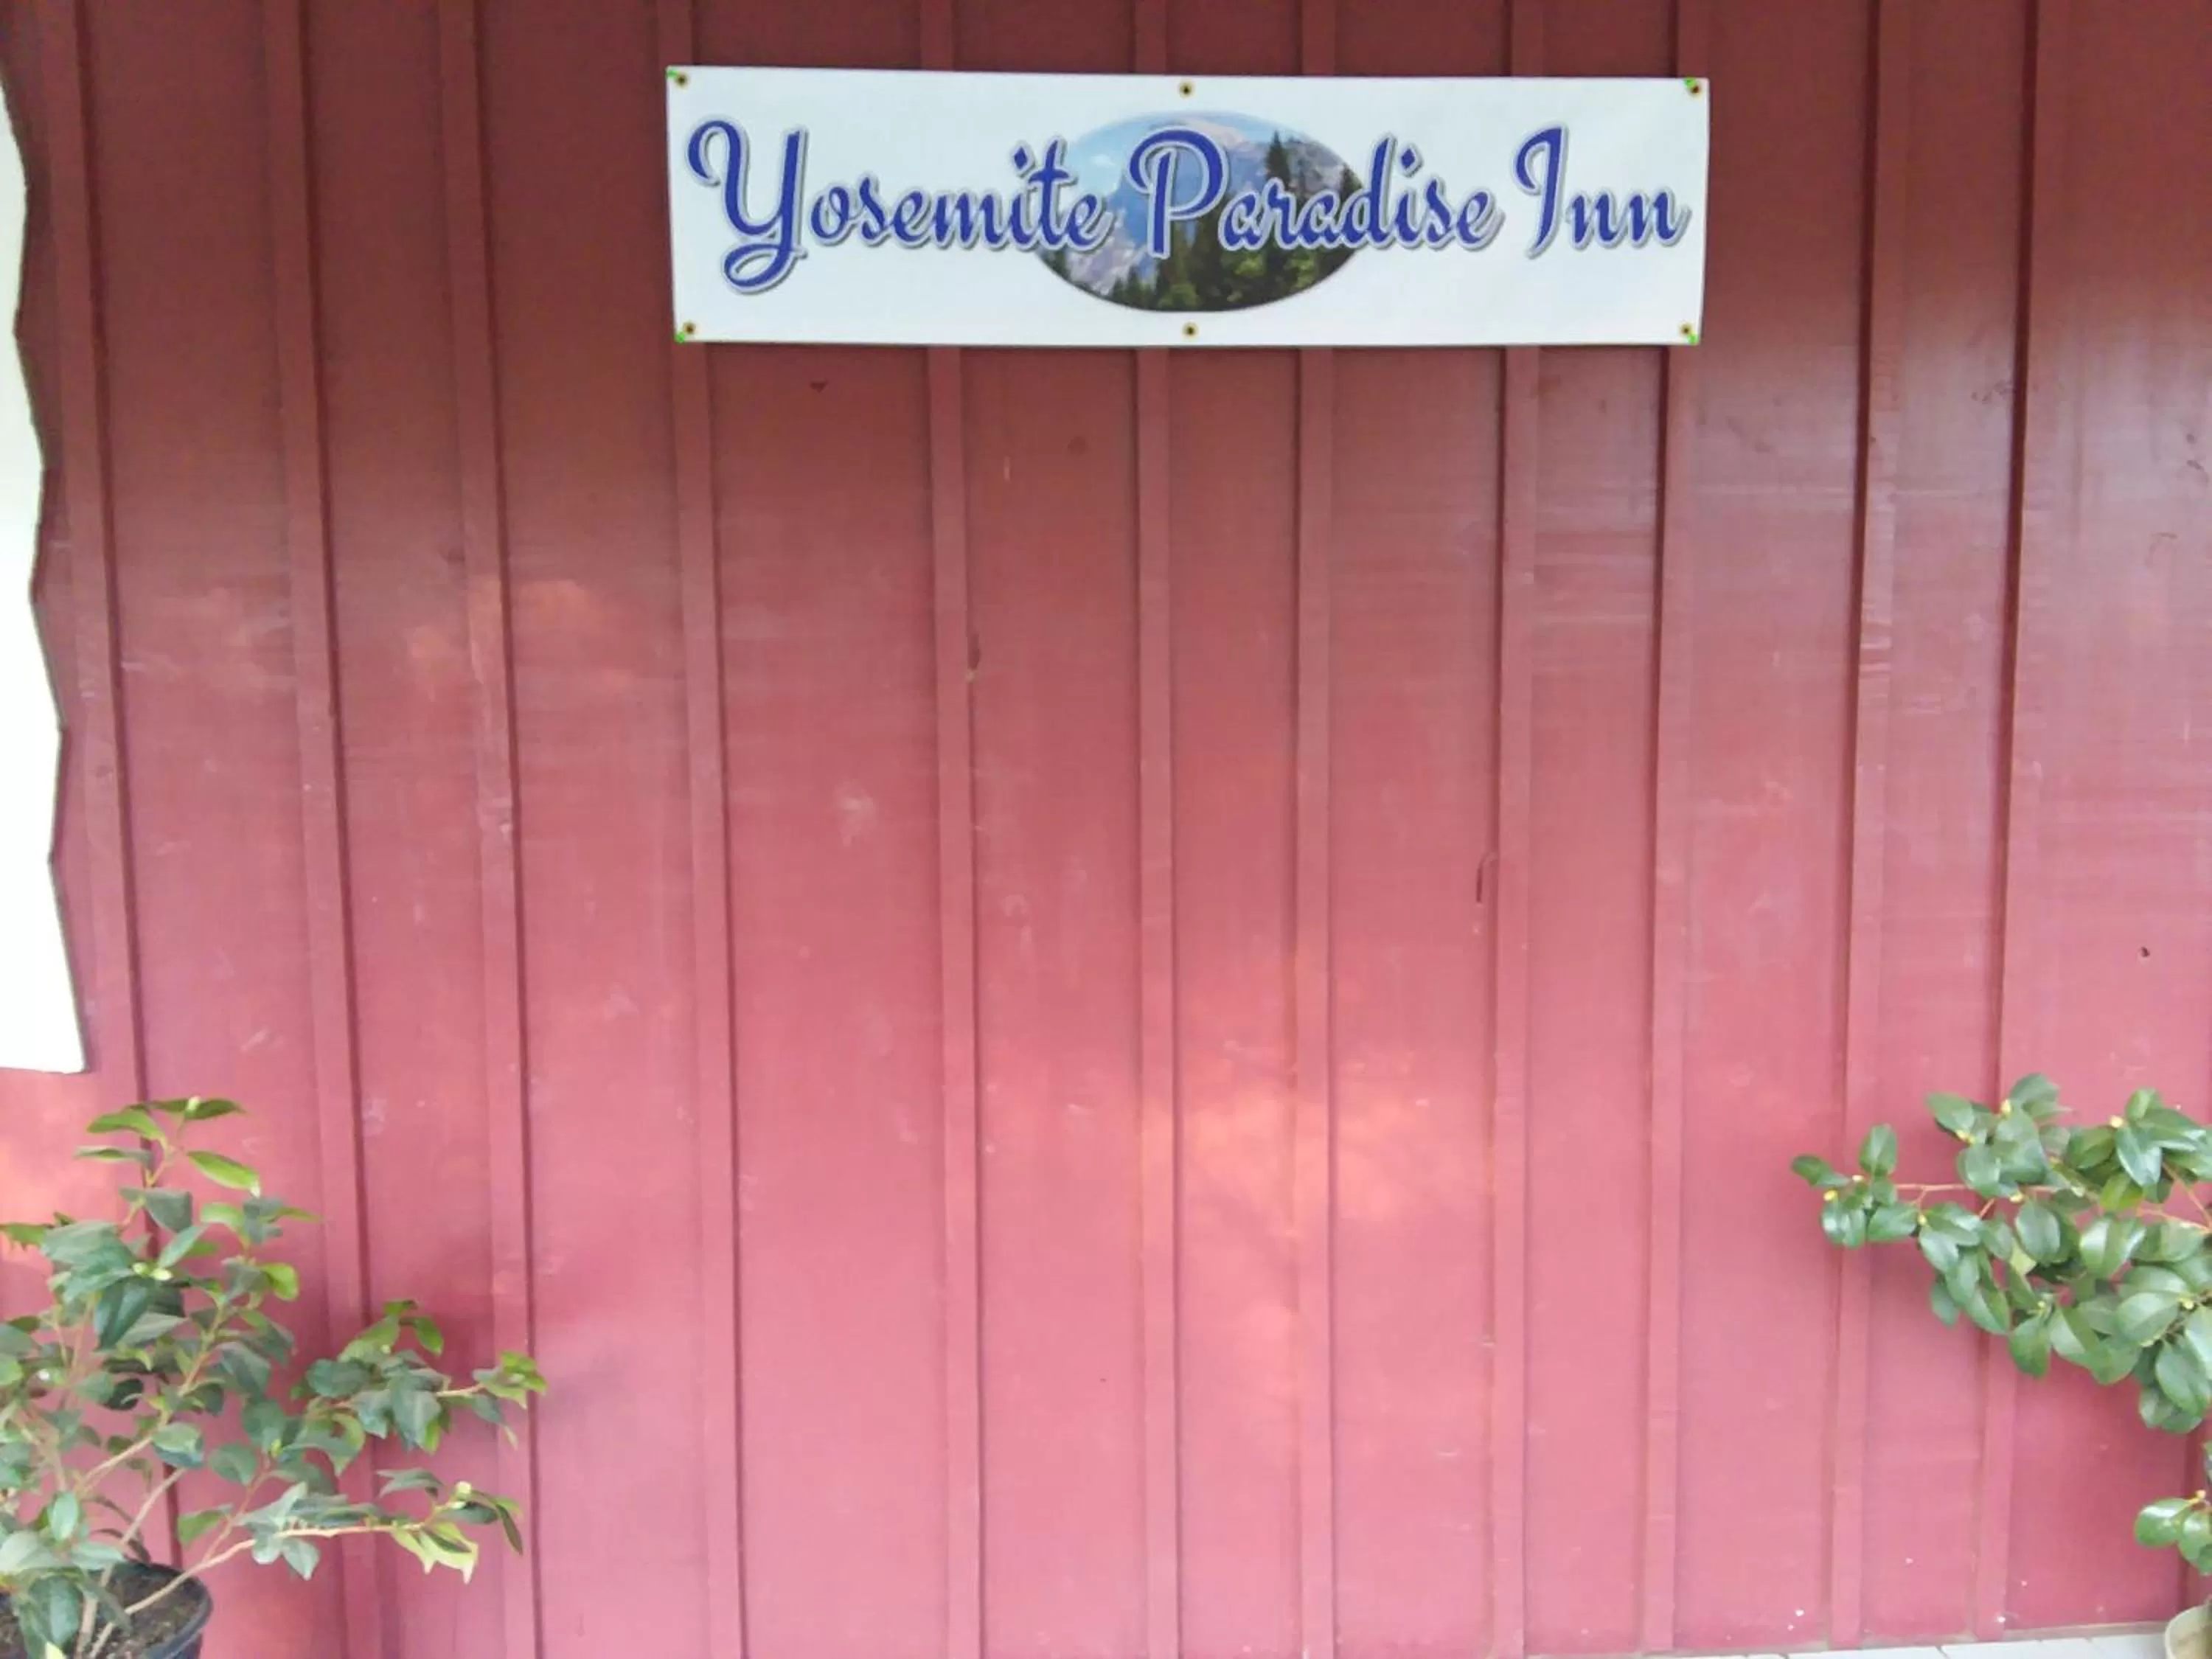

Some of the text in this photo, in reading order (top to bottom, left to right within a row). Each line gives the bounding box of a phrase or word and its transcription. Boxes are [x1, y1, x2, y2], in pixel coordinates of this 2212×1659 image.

[686, 118, 1686, 290] Yosemite Paradise Inn
